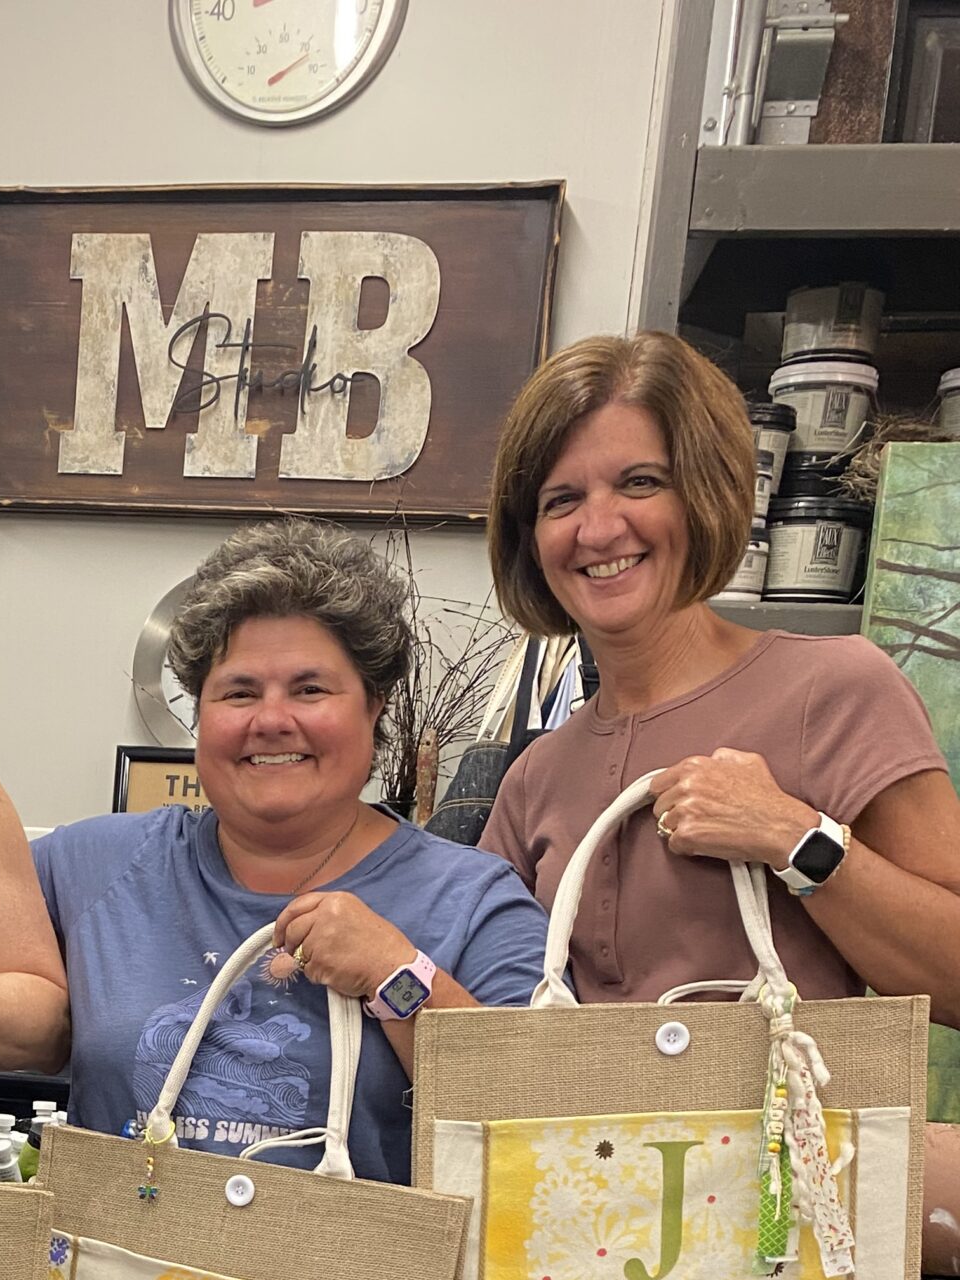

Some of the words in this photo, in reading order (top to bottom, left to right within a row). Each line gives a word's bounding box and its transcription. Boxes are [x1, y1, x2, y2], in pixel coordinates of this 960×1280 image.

[58, 231, 441, 481] MB
[168, 312, 365, 421] Studio
[165, 774, 201, 797] TH
